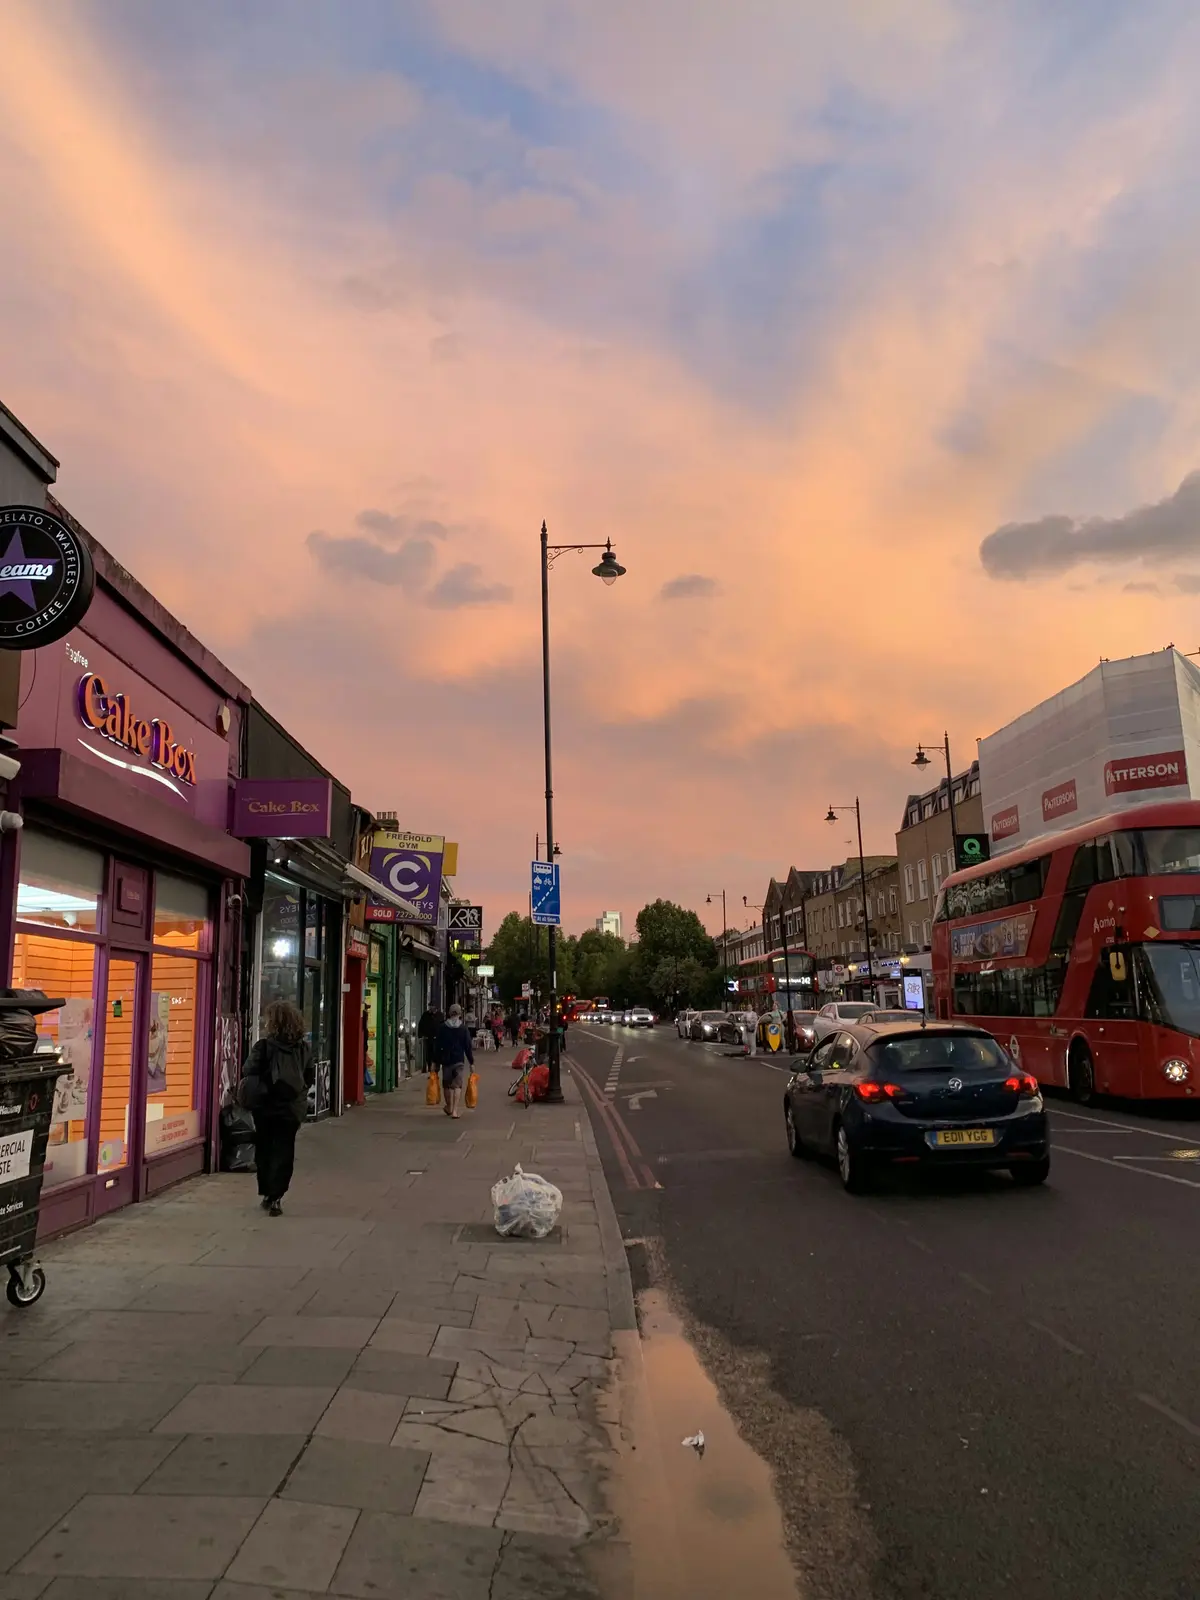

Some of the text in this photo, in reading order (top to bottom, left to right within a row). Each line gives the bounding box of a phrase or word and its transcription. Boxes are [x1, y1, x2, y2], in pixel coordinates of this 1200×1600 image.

[0, 513, 44, 525] ELATO
[55, 530, 77, 585] WAFFLES
[15, 600, 63, 633] COFFEE
[78, 672, 197, 786] Cake Box
[1105, 762, 1180, 785] PATTERSON
[248, 800, 320, 813] Cake Box
[1043, 789, 1076, 812] PATTERSON
[992, 814, 1018, 833] PATTERSON
[385, 832, 433, 843] FREEHOLD
[398, 841, 419, 850] GYM
[372, 908, 392, 918] SOLD
[967, 1128, 989, 1142] YGG
[0, 1139, 25, 1159] ERCIAL
